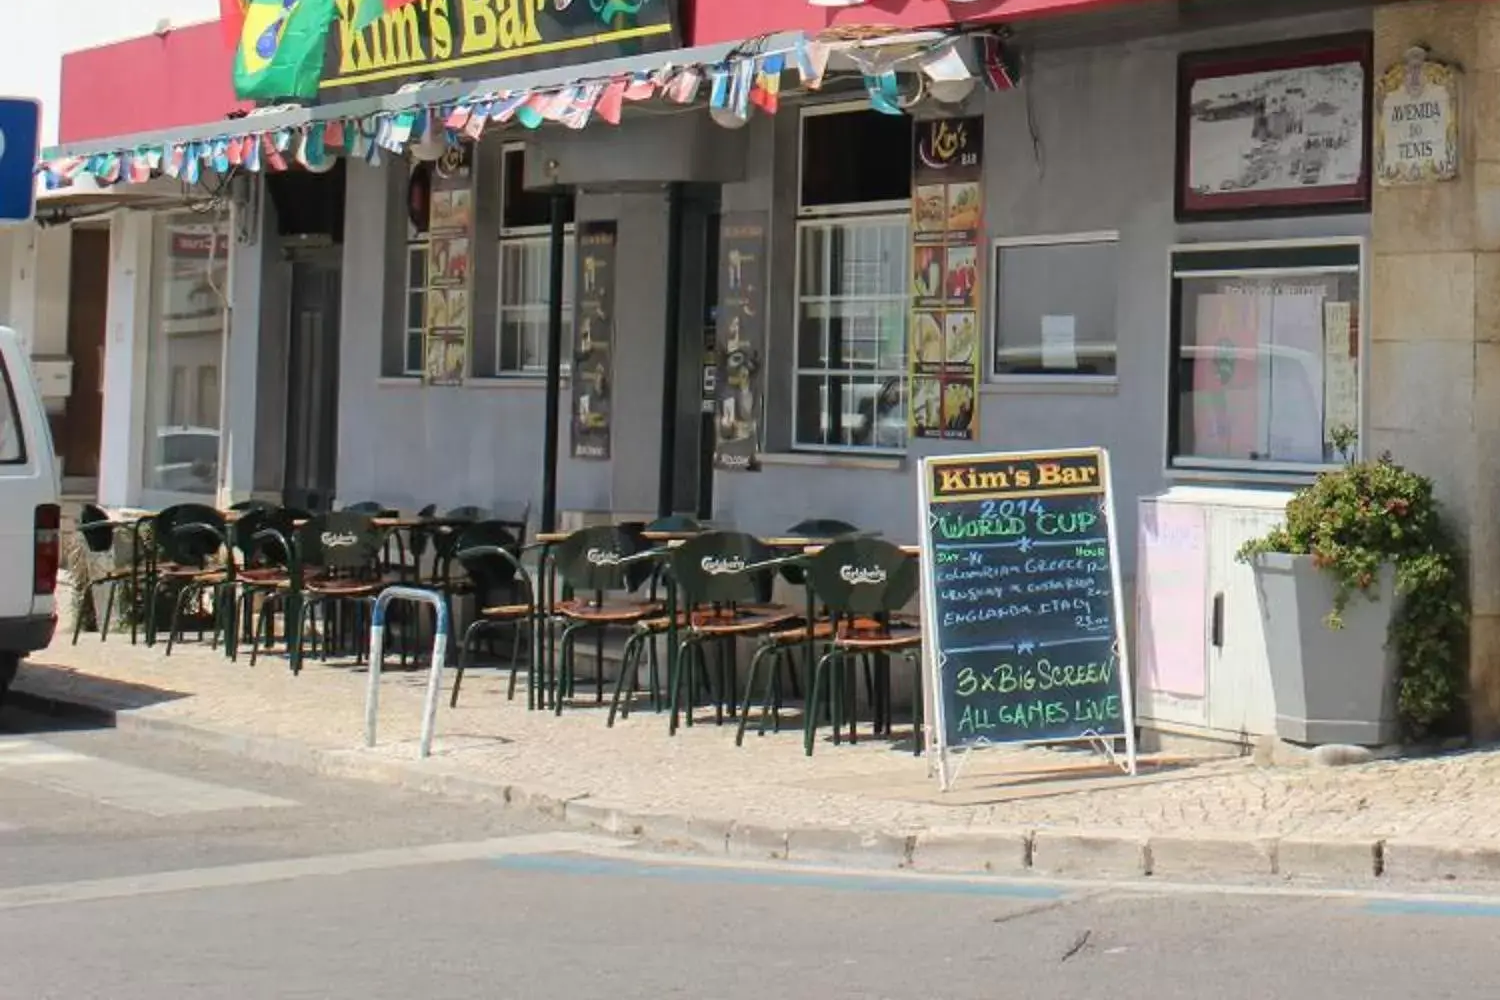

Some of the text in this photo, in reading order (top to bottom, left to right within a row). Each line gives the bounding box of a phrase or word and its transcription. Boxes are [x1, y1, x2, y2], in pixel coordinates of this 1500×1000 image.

[1392, 100, 1441, 122] AVENIDA
[961, 153, 977, 166] BAR
[938, 460, 1097, 492] Kim's Bar
[980, 499, 1045, 519] 2014
[938, 511, 1097, 539] WORLD CUP
[701, 556, 745, 574] Carlsberg
[840, 565, 887, 585] Carlsberg
[1038, 656, 1115, 690] SCREEN
[958, 694, 1120, 734] ALL GAMES LIVE
